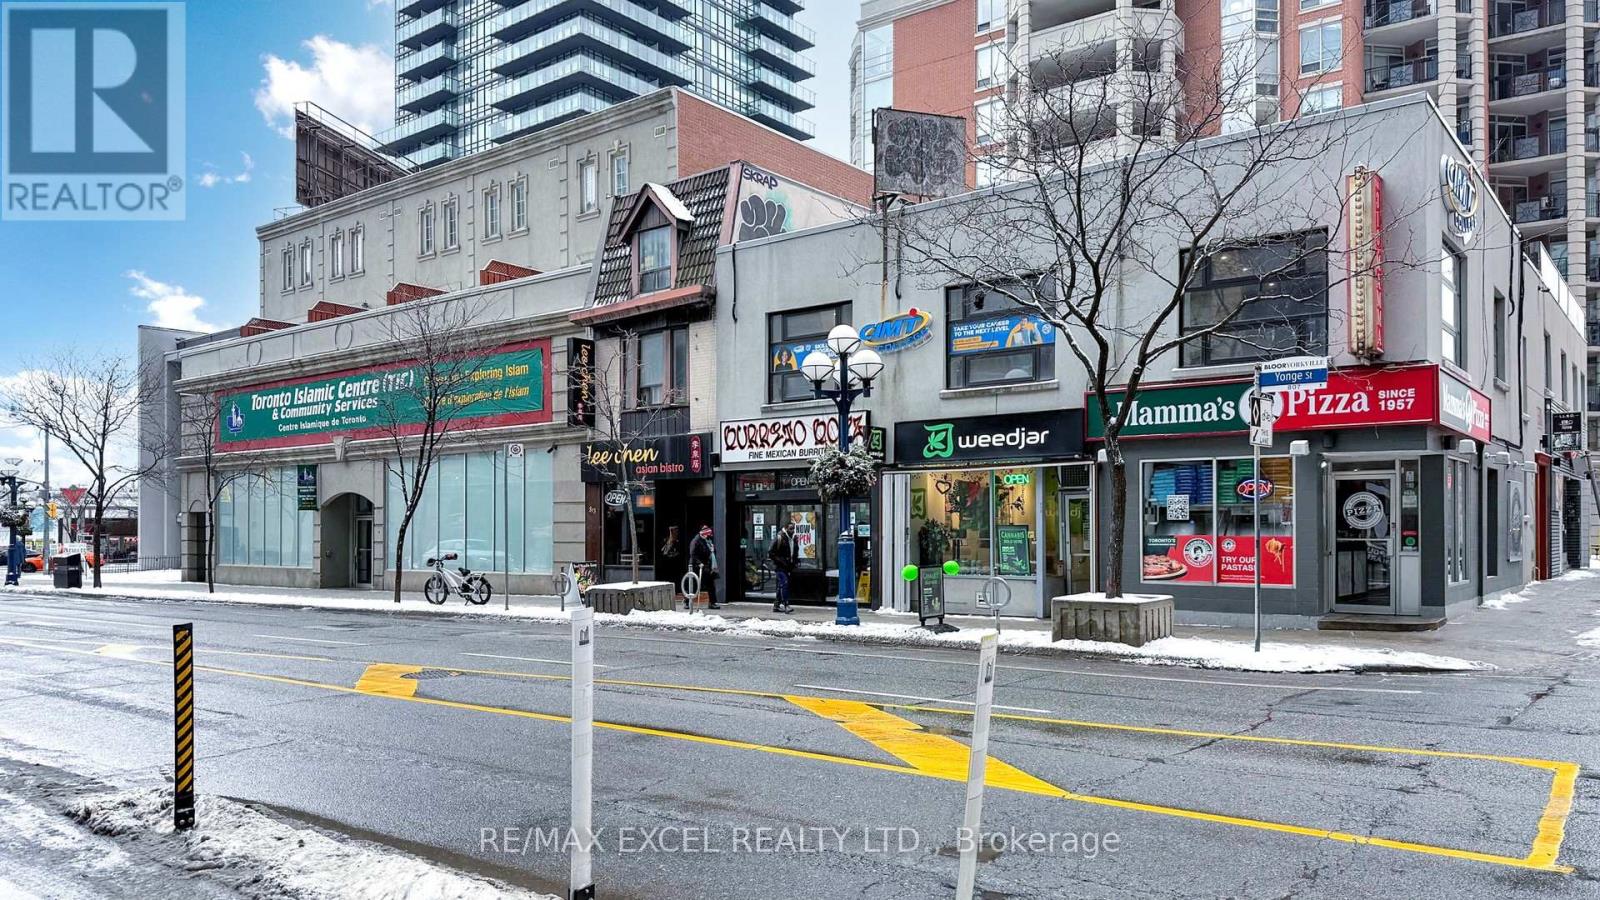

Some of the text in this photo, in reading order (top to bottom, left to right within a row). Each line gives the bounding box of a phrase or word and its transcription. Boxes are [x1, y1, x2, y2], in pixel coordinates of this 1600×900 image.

[743, 168, 778, 190] SKRAP
[860, 317, 923, 341] CIMT
[986, 319, 1010, 328] CAREER
[991, 325, 1010, 333] LEVEL
[506, 364, 529, 377] Islam
[1274, 371, 1313, 382] Yonge St
[1287, 383, 1300, 391] 807
[1378, 388, 1416, 399] SINCE
[251, 390, 291, 411] Toronto
[294, 383, 335, 405] Islamic
[338, 378, 380, 399] Centre
[272, 396, 378, 420] & Community Services
[1286, 388, 1370, 417] Pizza
[1379, 398, 1415, 411] 1957
[278, 415, 367, 432] Centre Islamique de Toronto
[958, 427, 1049, 449] weedjar
[586, 445, 613, 465] lee
[748, 452, 763, 460] FINE
[765, 450, 797, 460] MEXICAN
[635, 462, 684, 474] asian bistro
[791, 477, 810, 487] OPEN
[1004, 474, 1029, 485] OPEN
[606, 491, 626, 505] OPEN
[1346, 504, 1381, 517] PIZZA
[795, 524, 811, 534] NOW
[1000, 531, 1025, 539] CANNABIS
